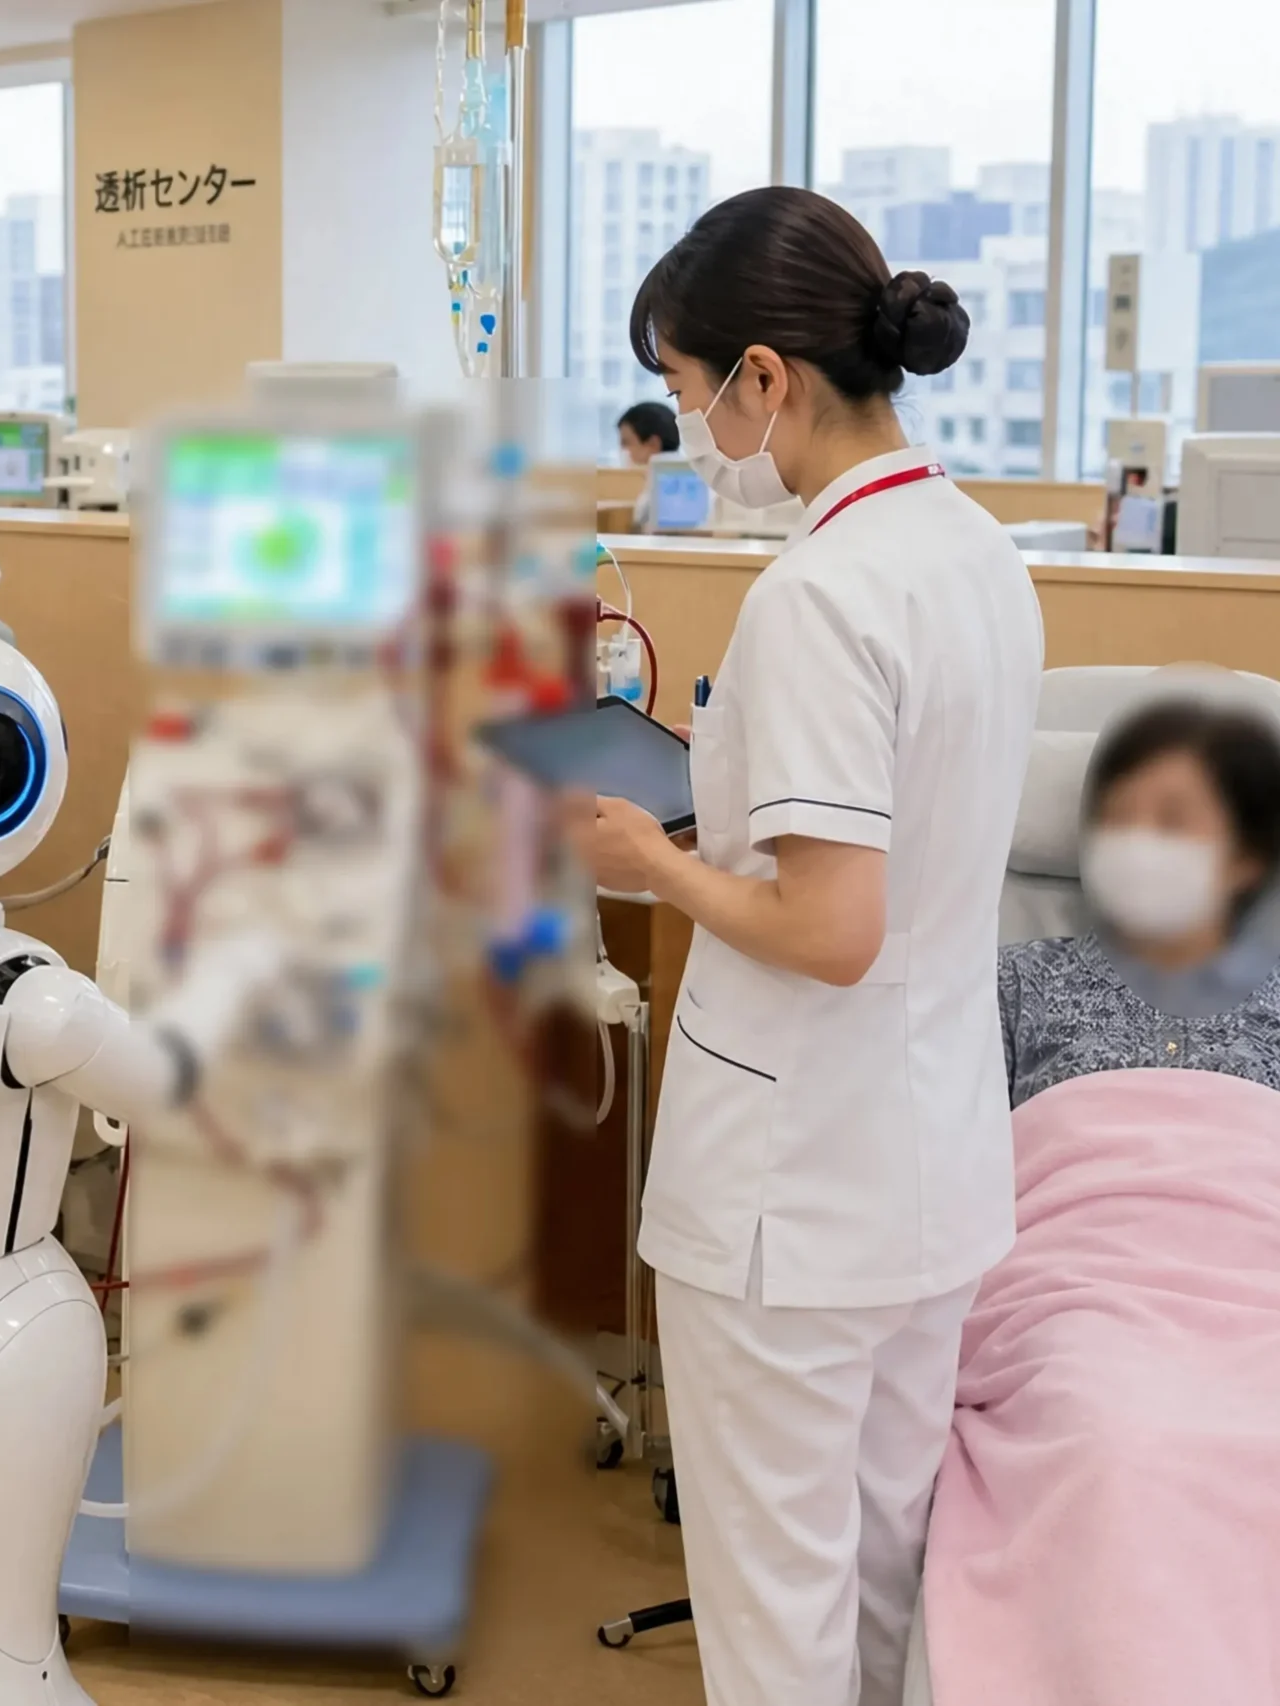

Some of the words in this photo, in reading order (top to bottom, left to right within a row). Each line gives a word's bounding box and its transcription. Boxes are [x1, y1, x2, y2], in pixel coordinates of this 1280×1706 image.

[95, 164, 256, 213] 透析センター
